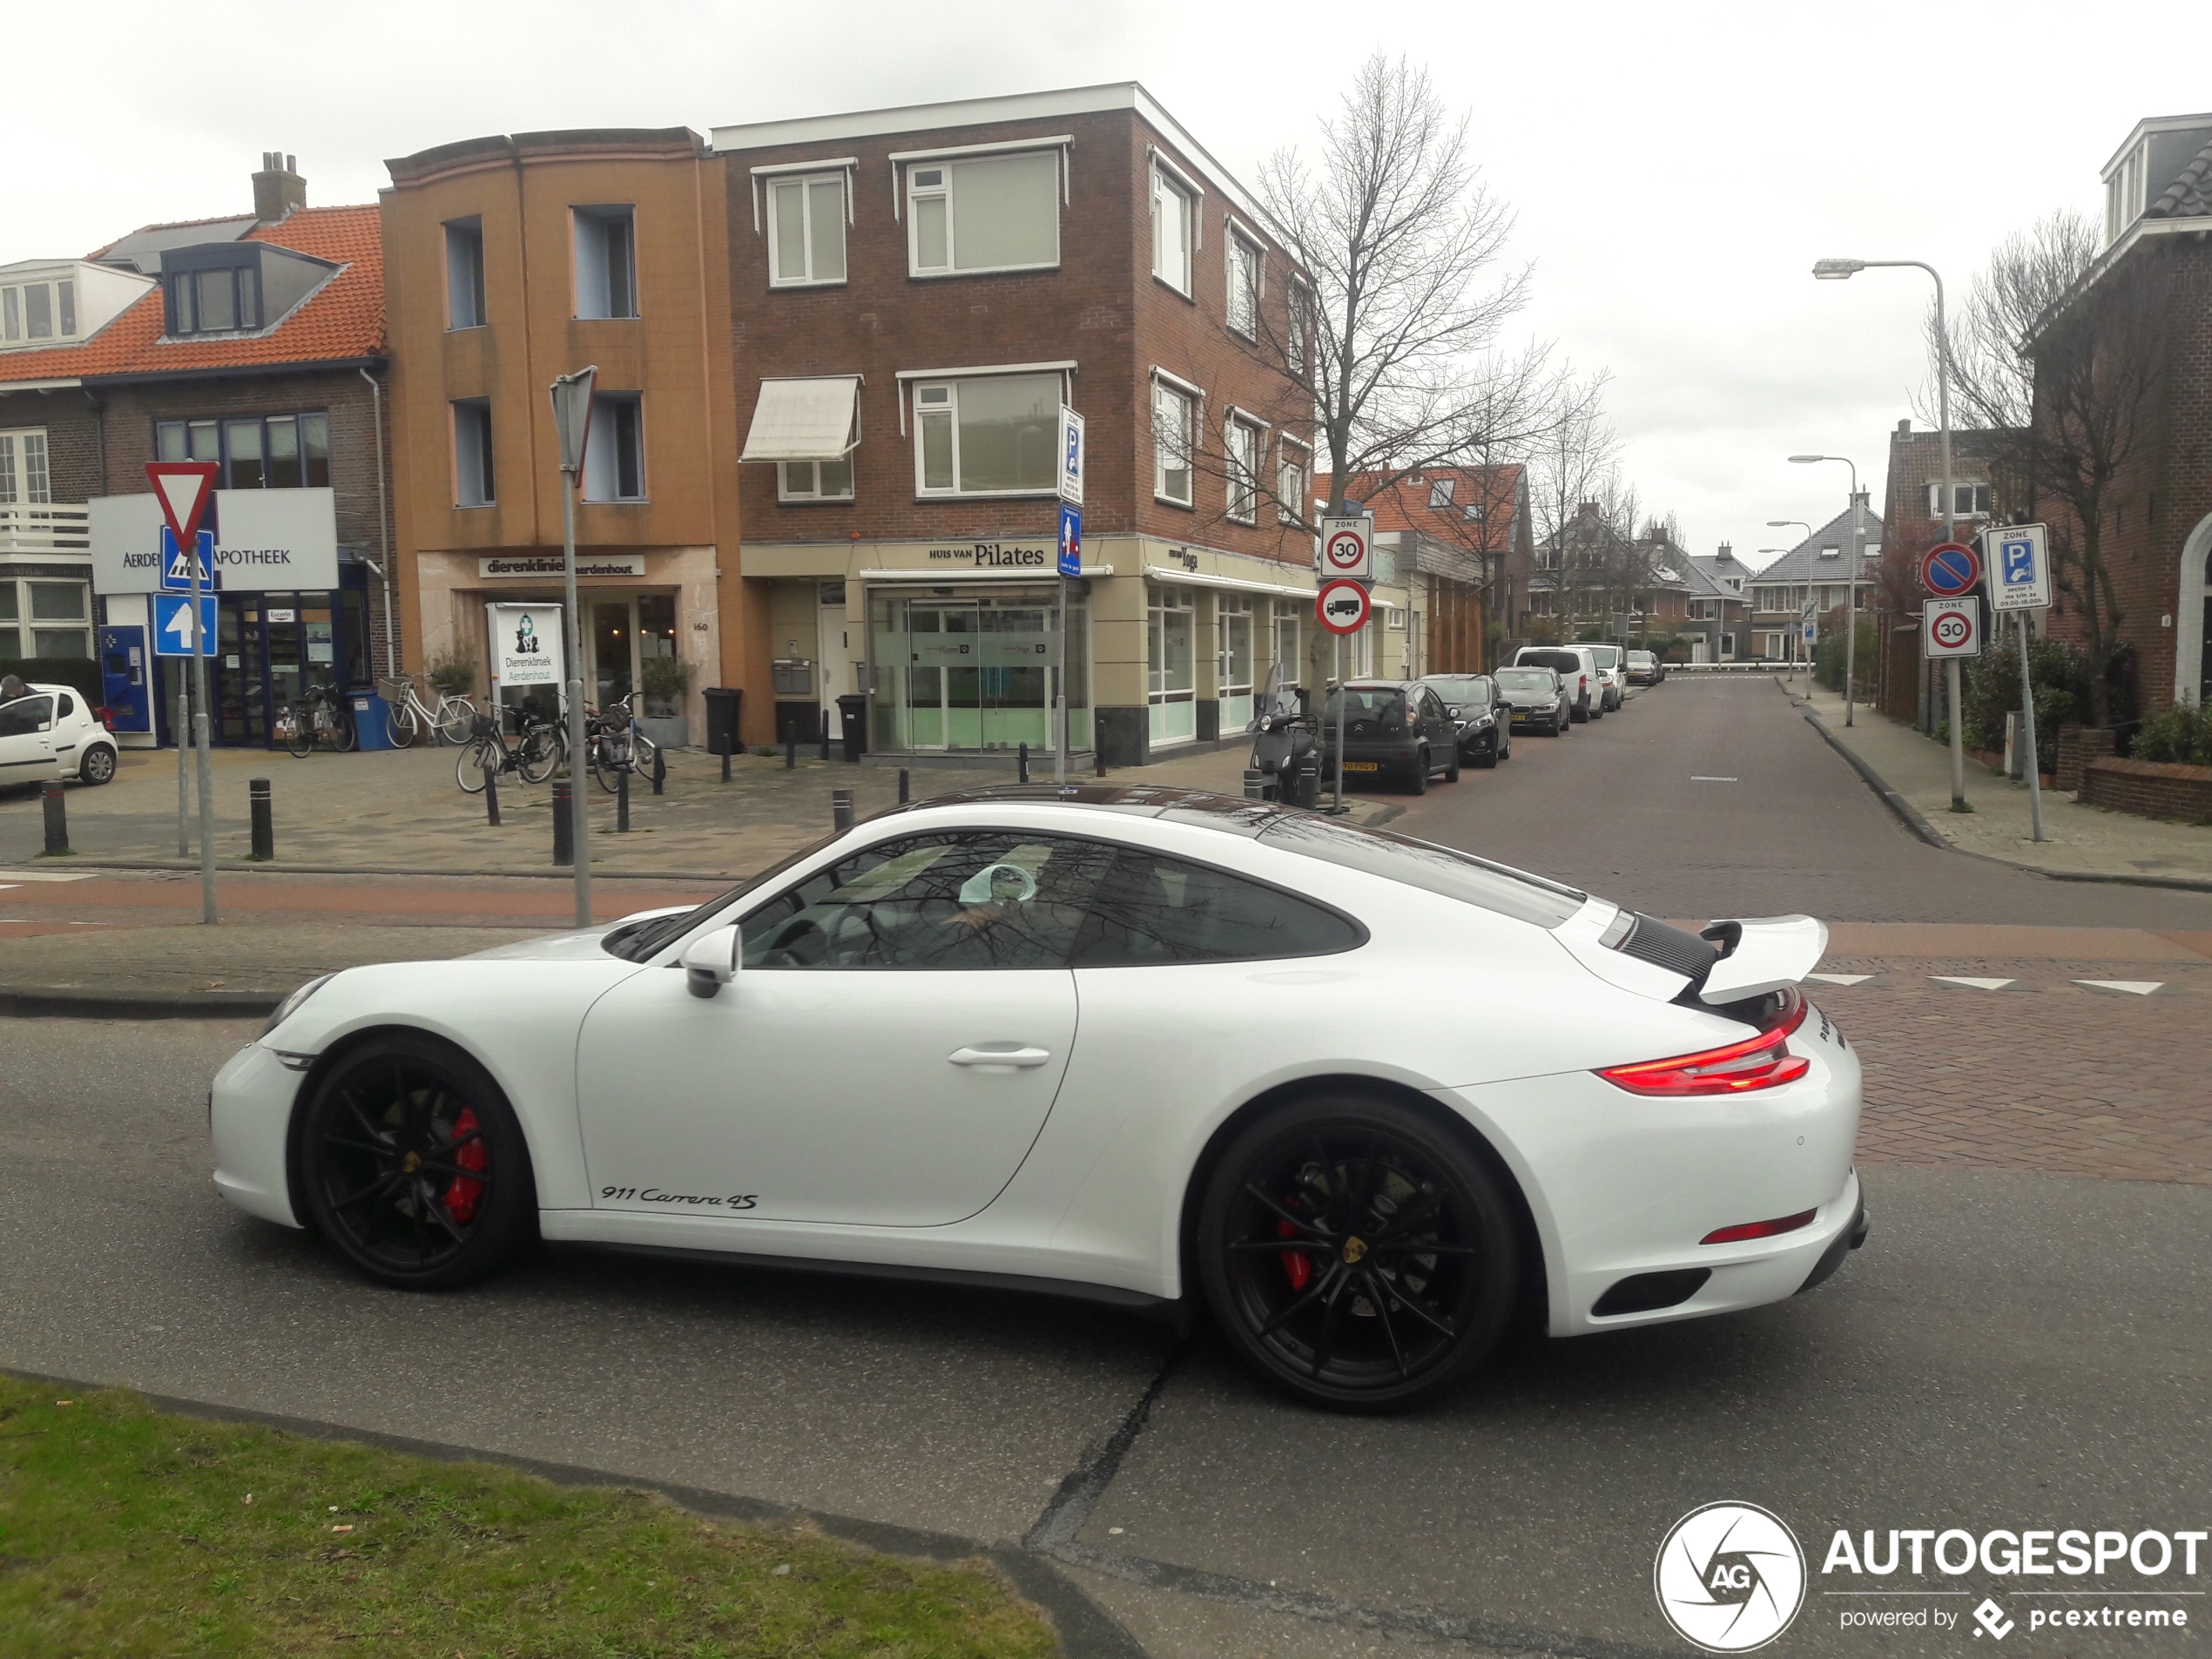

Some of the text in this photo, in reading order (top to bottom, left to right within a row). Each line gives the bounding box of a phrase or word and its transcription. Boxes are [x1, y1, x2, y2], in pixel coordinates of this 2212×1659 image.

[1069, 429, 1077, 453] P
[2003, 530, 2029, 540] ZONE
[929, 550, 952, 558] HUIS
[974, 543, 1044, 566] Pilates
[1334, 543, 1357, 557] 30
[2008, 544, 2026, 567] P
[1181, 546, 1198, 573] Yoga
[693, 623, 708, 631] 160
[1939, 623, 1964, 637] 30
[505, 657, 552, 667] Dierenkliniek
[508, 671, 550, 681] Aerdenhout
[602, 1186, 759, 1210] 911 Carrera 4S
